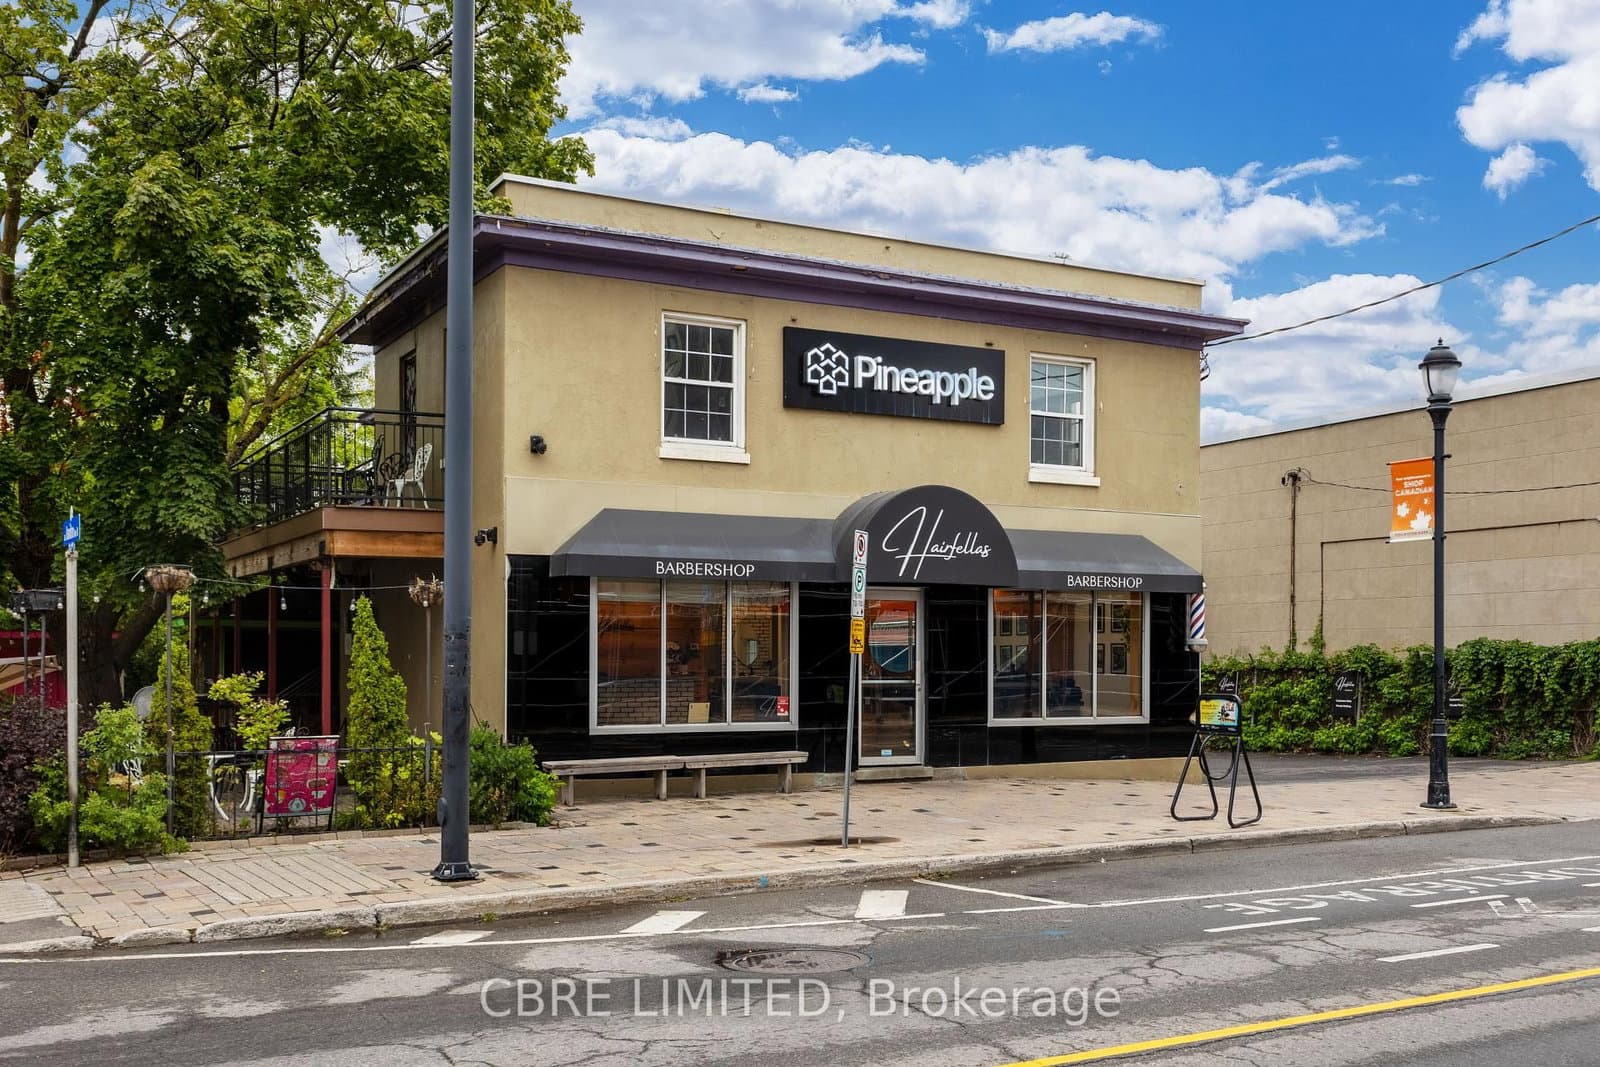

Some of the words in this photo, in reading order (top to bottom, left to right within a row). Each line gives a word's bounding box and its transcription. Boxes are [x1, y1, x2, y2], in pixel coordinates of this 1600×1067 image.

[854, 355, 995, 406] Pineapple
[1403, 479, 1424, 488] SHOP
[882, 506, 992, 580] Hairfellas
[656, 561, 755, 577] BARBERSHOP
[1067, 575, 1143, 589] BARBERSHOP
